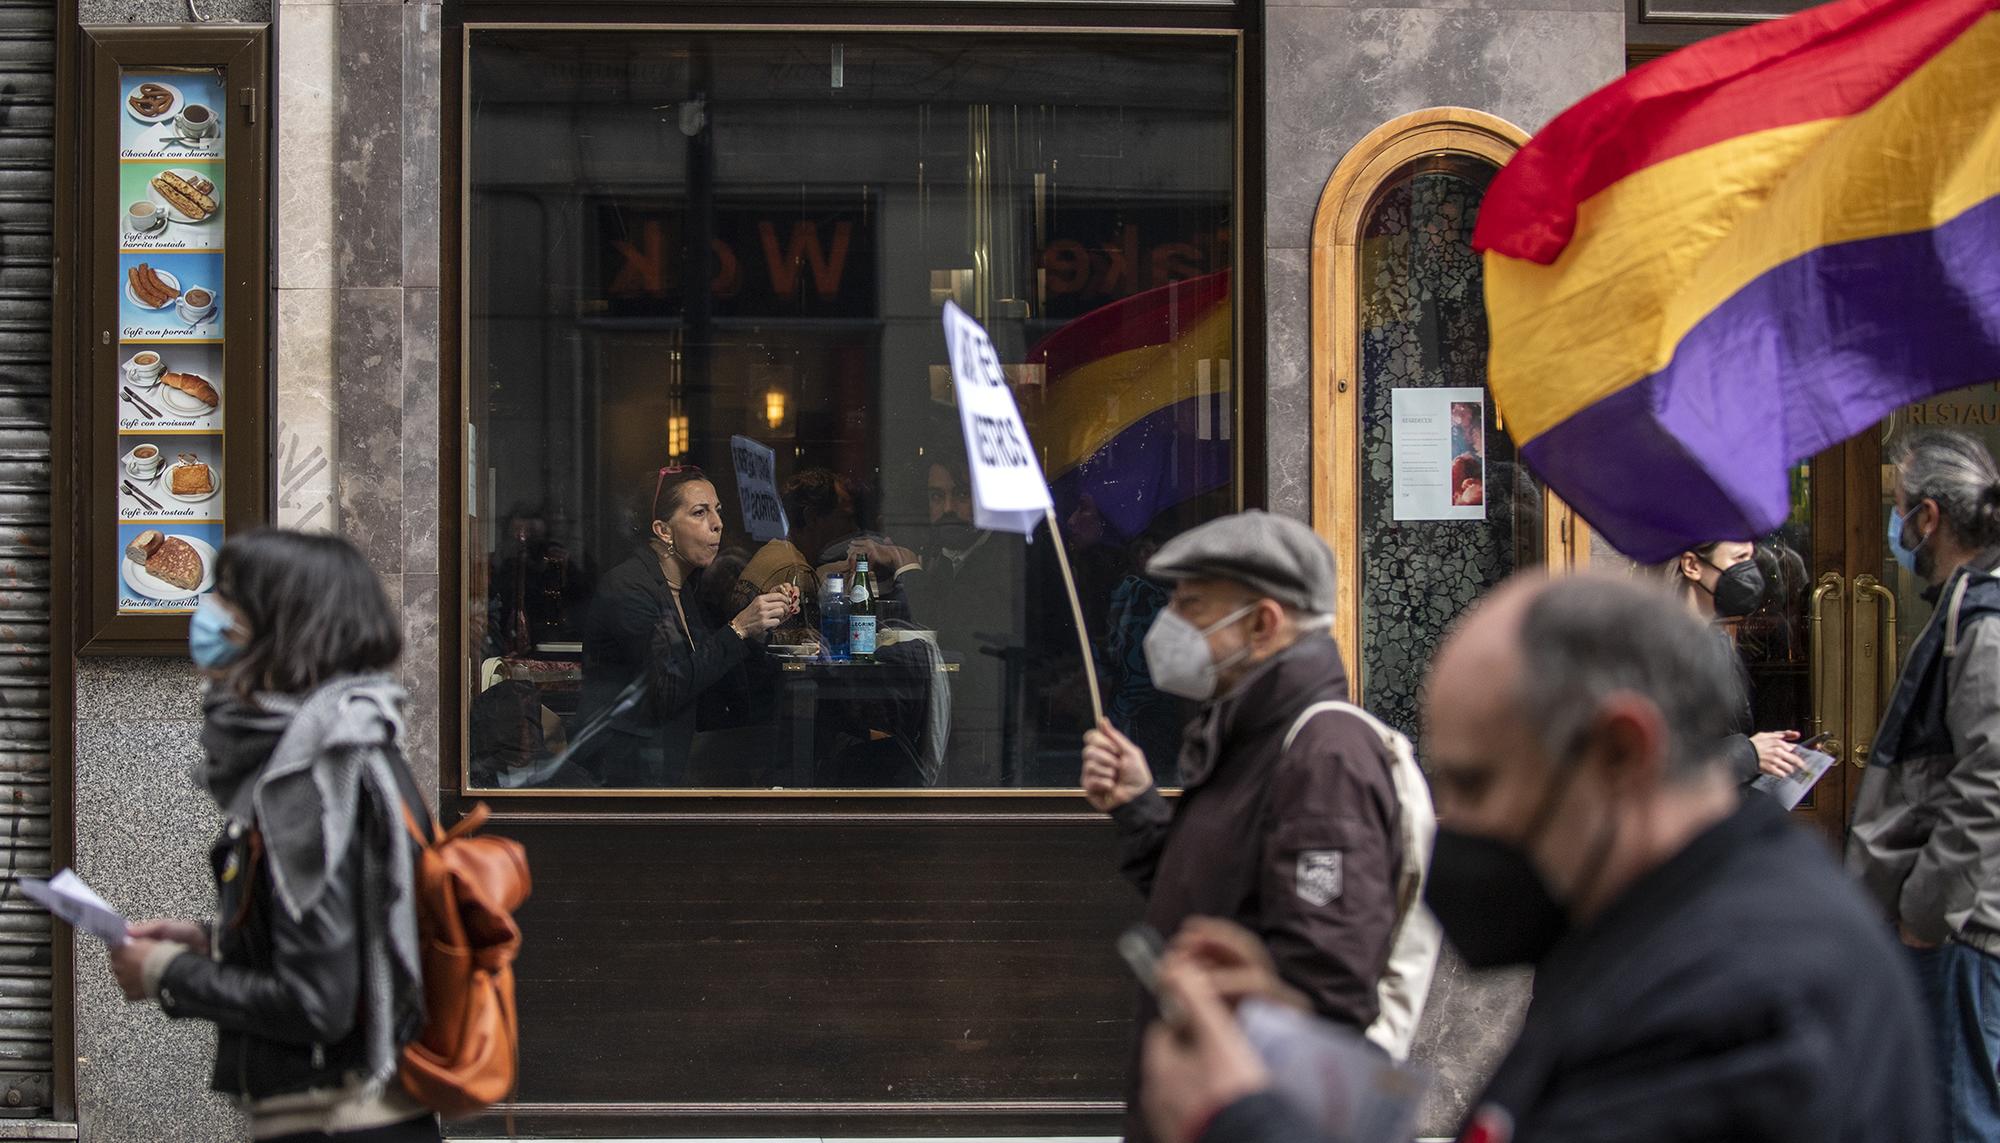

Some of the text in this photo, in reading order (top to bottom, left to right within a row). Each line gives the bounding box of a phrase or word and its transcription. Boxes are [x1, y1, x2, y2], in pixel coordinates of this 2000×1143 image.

[121, 149, 164, 158] Chocolate
[184, 149, 219, 158] churros
[122, 240, 186, 248] barrita tostada
[160, 328, 194, 338] porras
[157, 419, 196, 427] croissant
[160, 507, 195, 516] tostada
[120, 598, 199, 607] Pincho de tortilla
